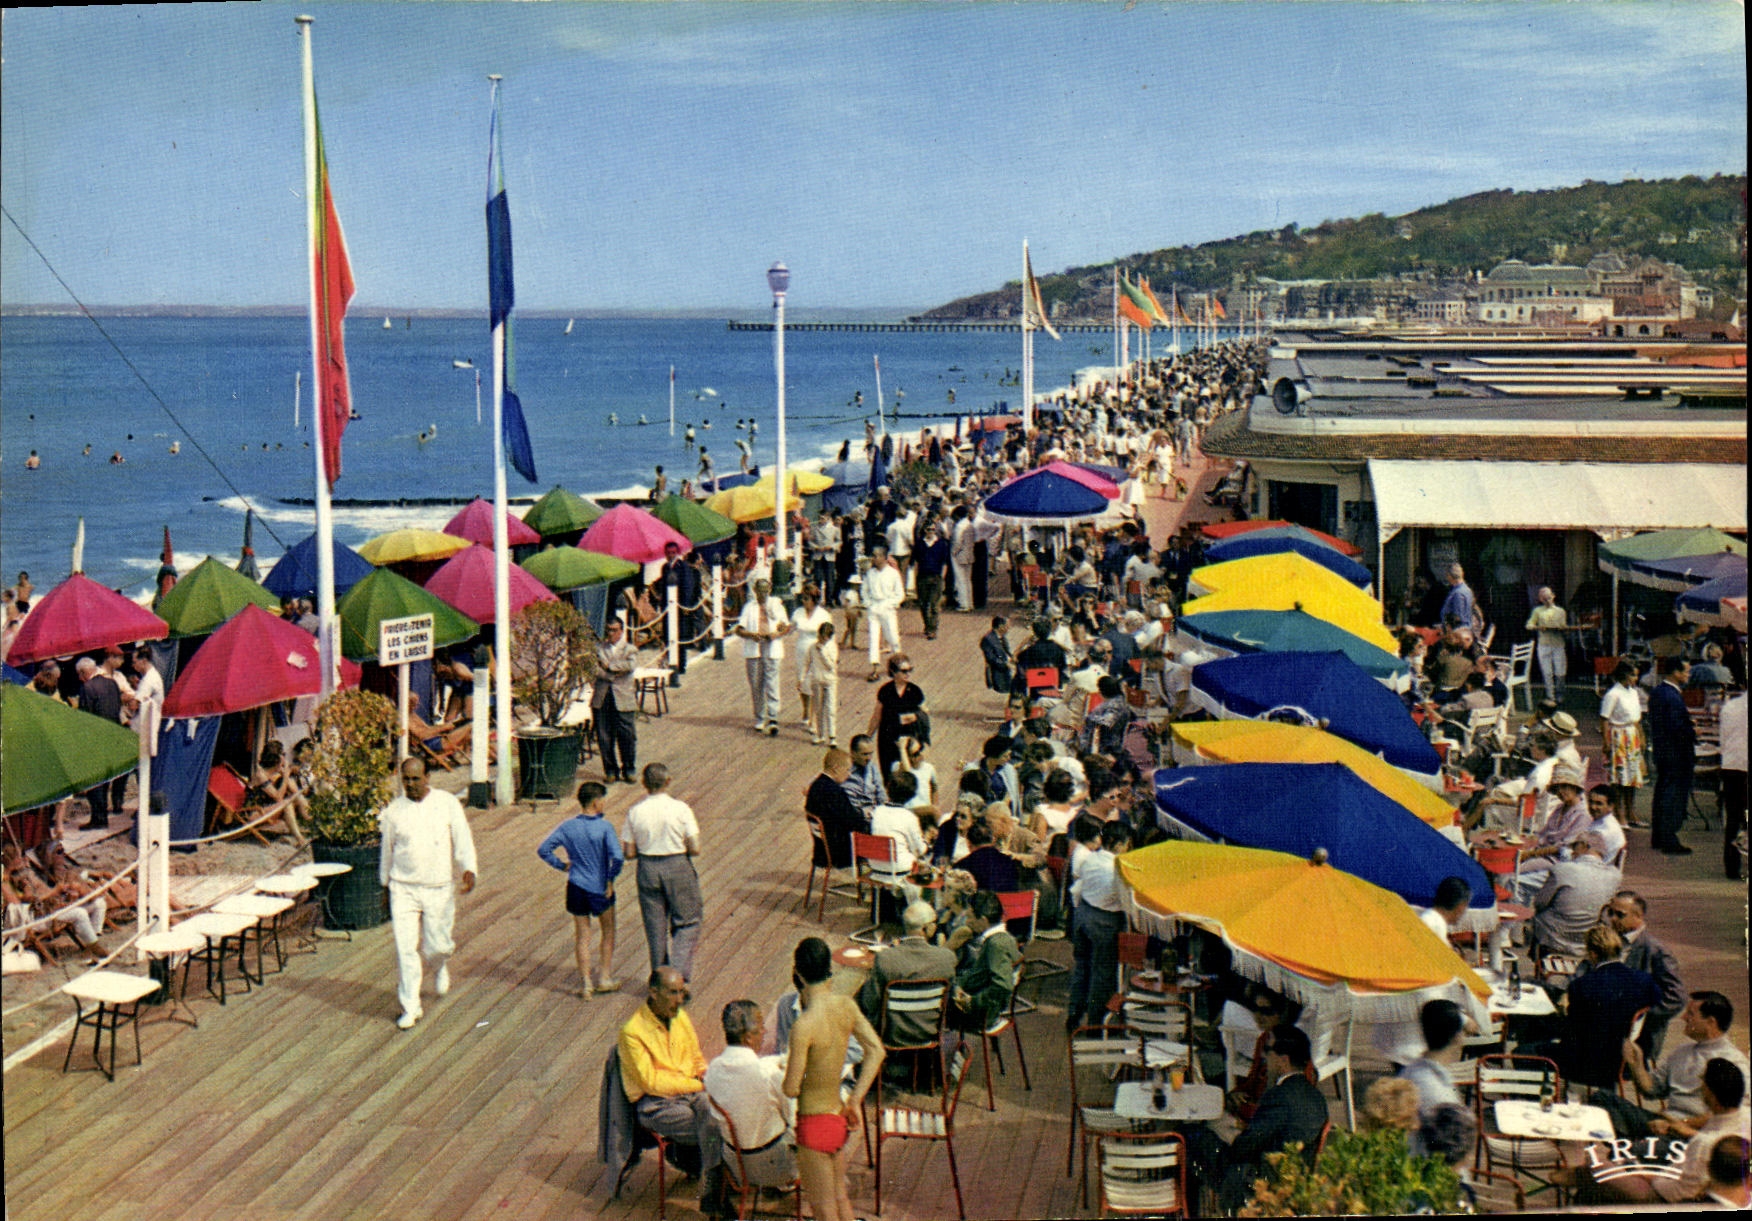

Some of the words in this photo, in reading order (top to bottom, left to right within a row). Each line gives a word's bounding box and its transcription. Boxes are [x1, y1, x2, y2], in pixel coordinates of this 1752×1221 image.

[387, 636, 401, 648] LES
[403, 632, 428, 645] CHIENS
[389, 650, 400, 661] EN
[404, 645, 427, 658] LAISSE
